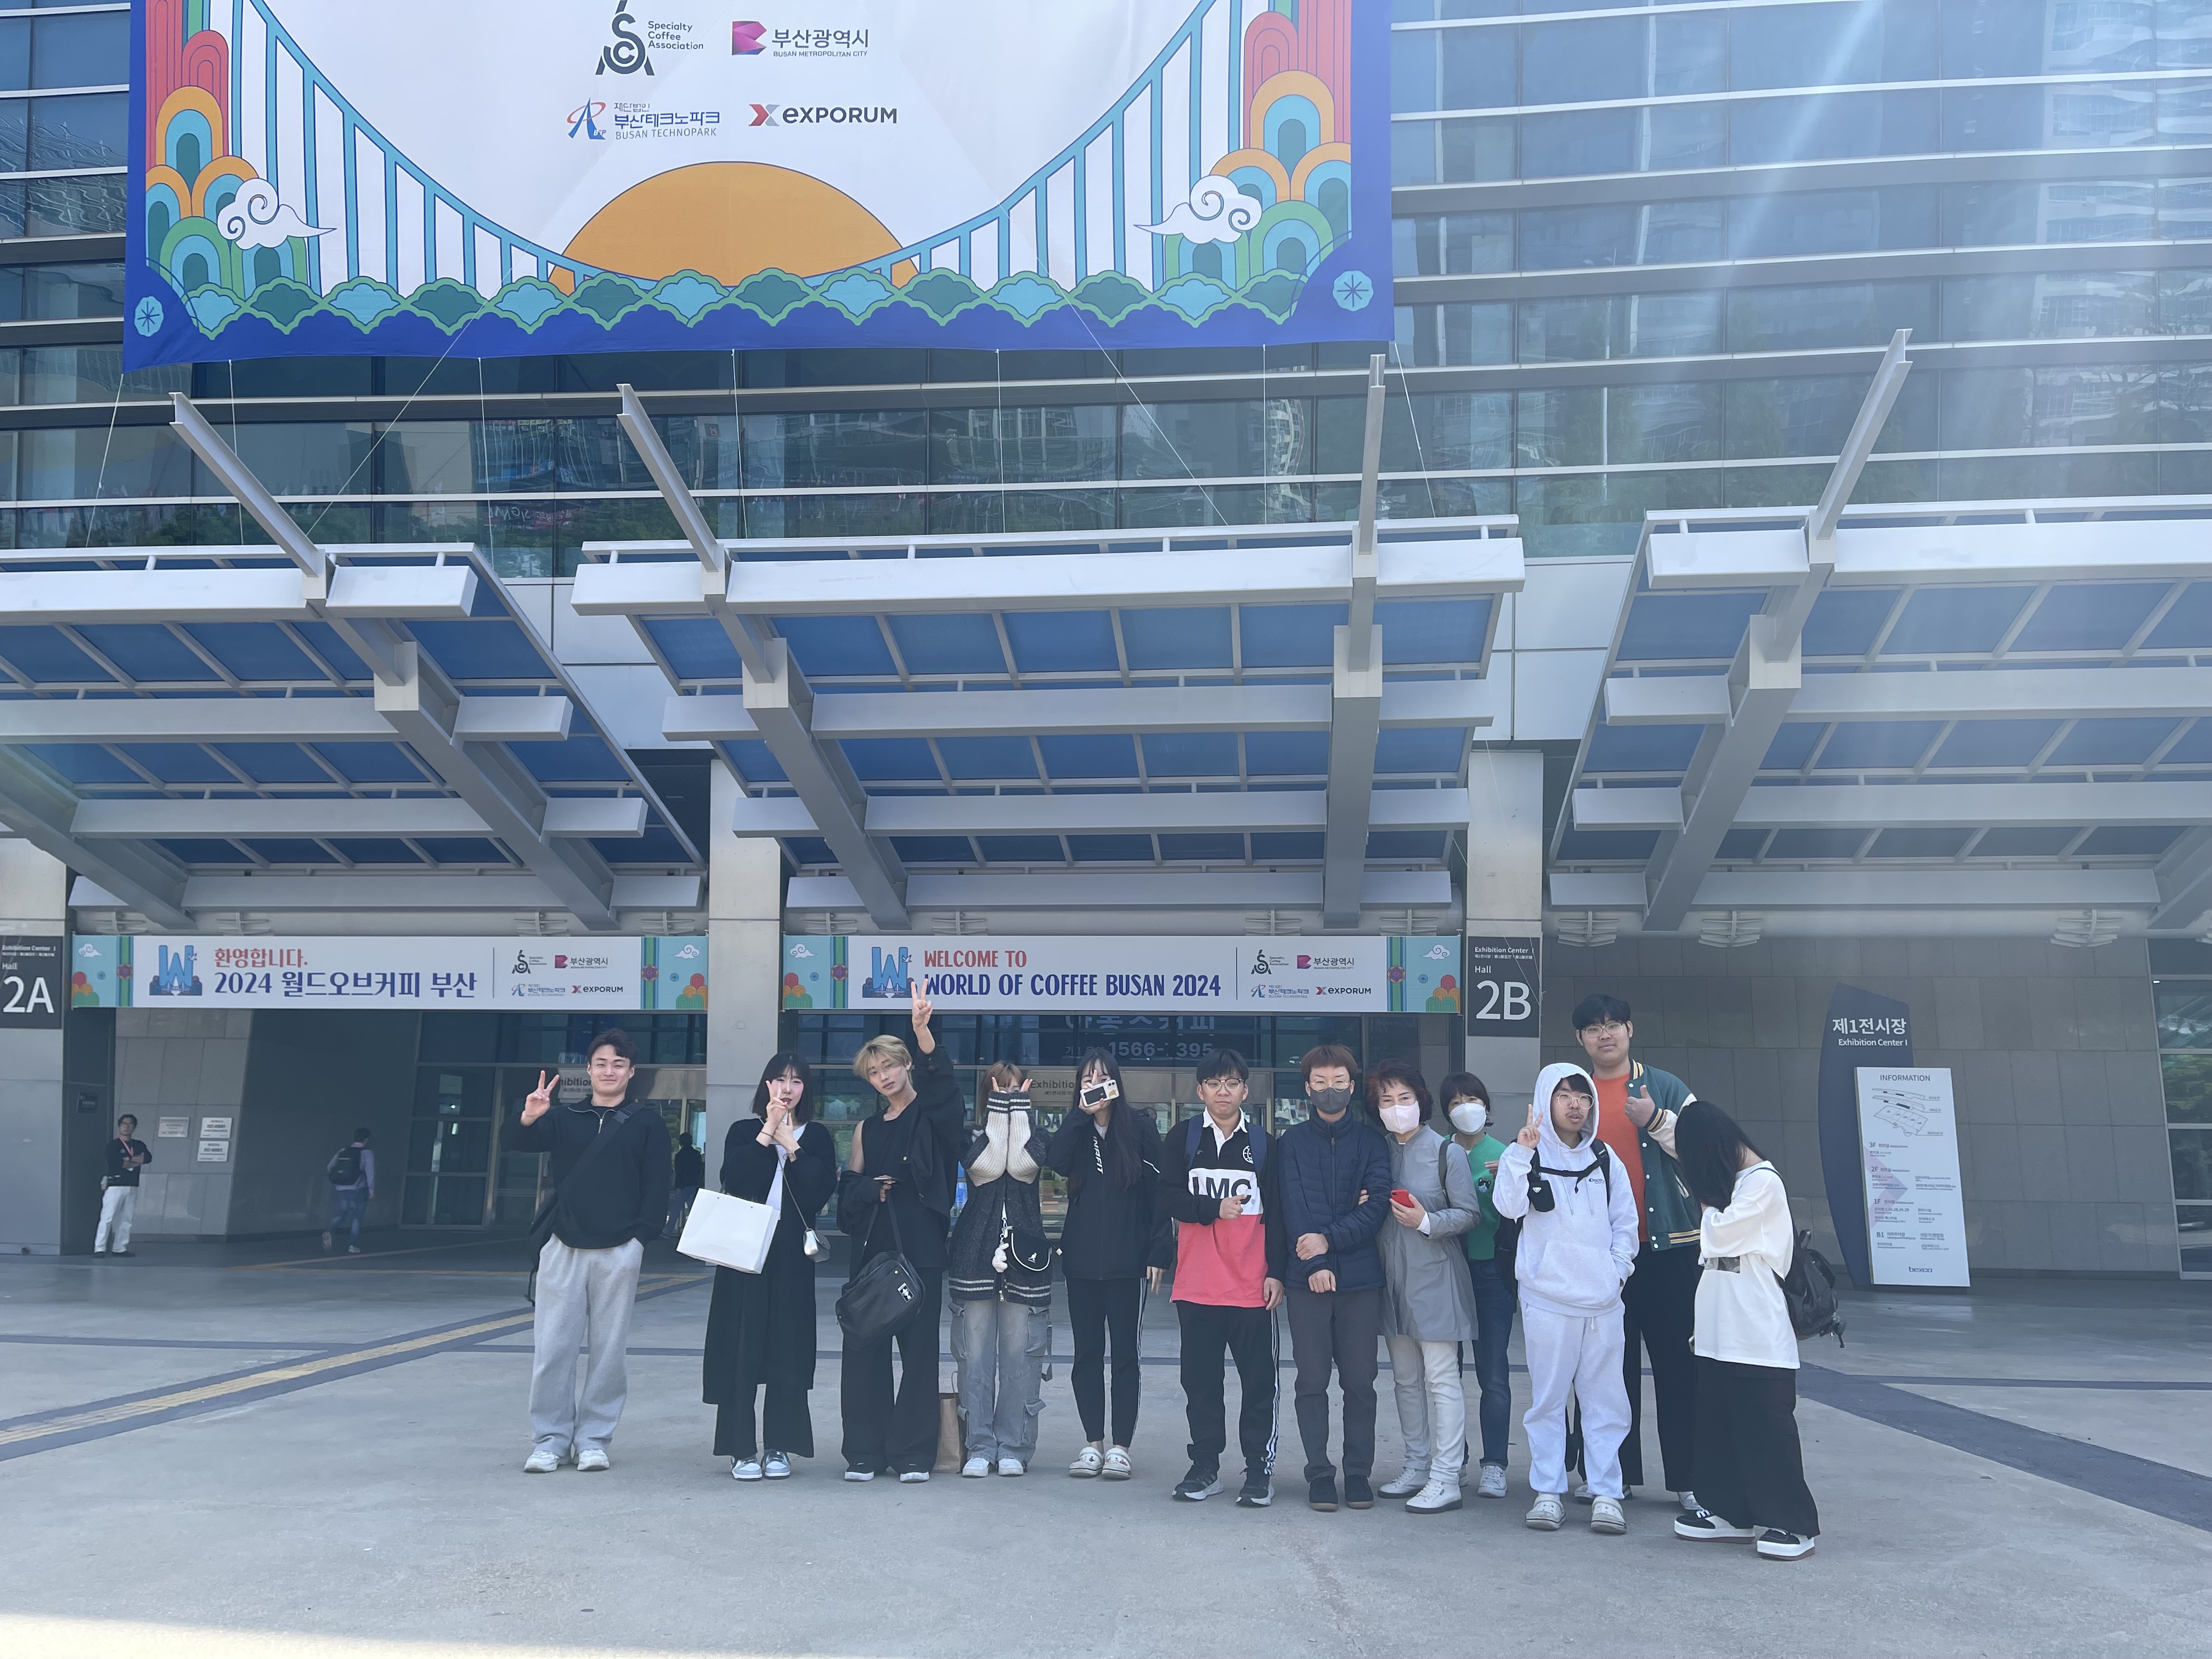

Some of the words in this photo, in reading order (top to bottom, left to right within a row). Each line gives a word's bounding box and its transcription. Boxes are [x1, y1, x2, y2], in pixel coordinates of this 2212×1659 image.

[648, 21, 693, 32] Specialty
[648, 31, 681, 40] Coffee
[772, 29, 868, 48] 부산광역시
[648, 40, 704, 49] Association
[614, 103, 650, 112] 재단법인
[614, 111, 720, 129] 부산테크노파크
[616, 131, 648, 140] BUSAN
[651, 128, 717, 138] TECHNOPARK
[214, 947, 308, 968] 환영합니다.
[570, 957, 608, 966] 부산광역시
[924, 950, 998, 968] WELCOME
[1005, 950, 1027, 968] TO
[1313, 957, 1354, 966] 부산광역시
[214, 972, 272, 994] 2024
[281, 972, 420, 997] 월드오브커피
[431, 972, 477, 998] 부산
[926, 974, 989, 996] WORLD
[999, 974, 1023, 996] OF
[1030, 974, 1098, 996] COFFEE
[1105, 974, 1165, 996] BUSAN
[1172, 975, 1221, 997] 2024
[3, 976, 54, 1013] 2A
[1476, 980, 1531, 1020] 2B
[1832, 1018, 1907, 1035] 제1전시장
[1031, 1080, 1074, 1088] Exhibitio
